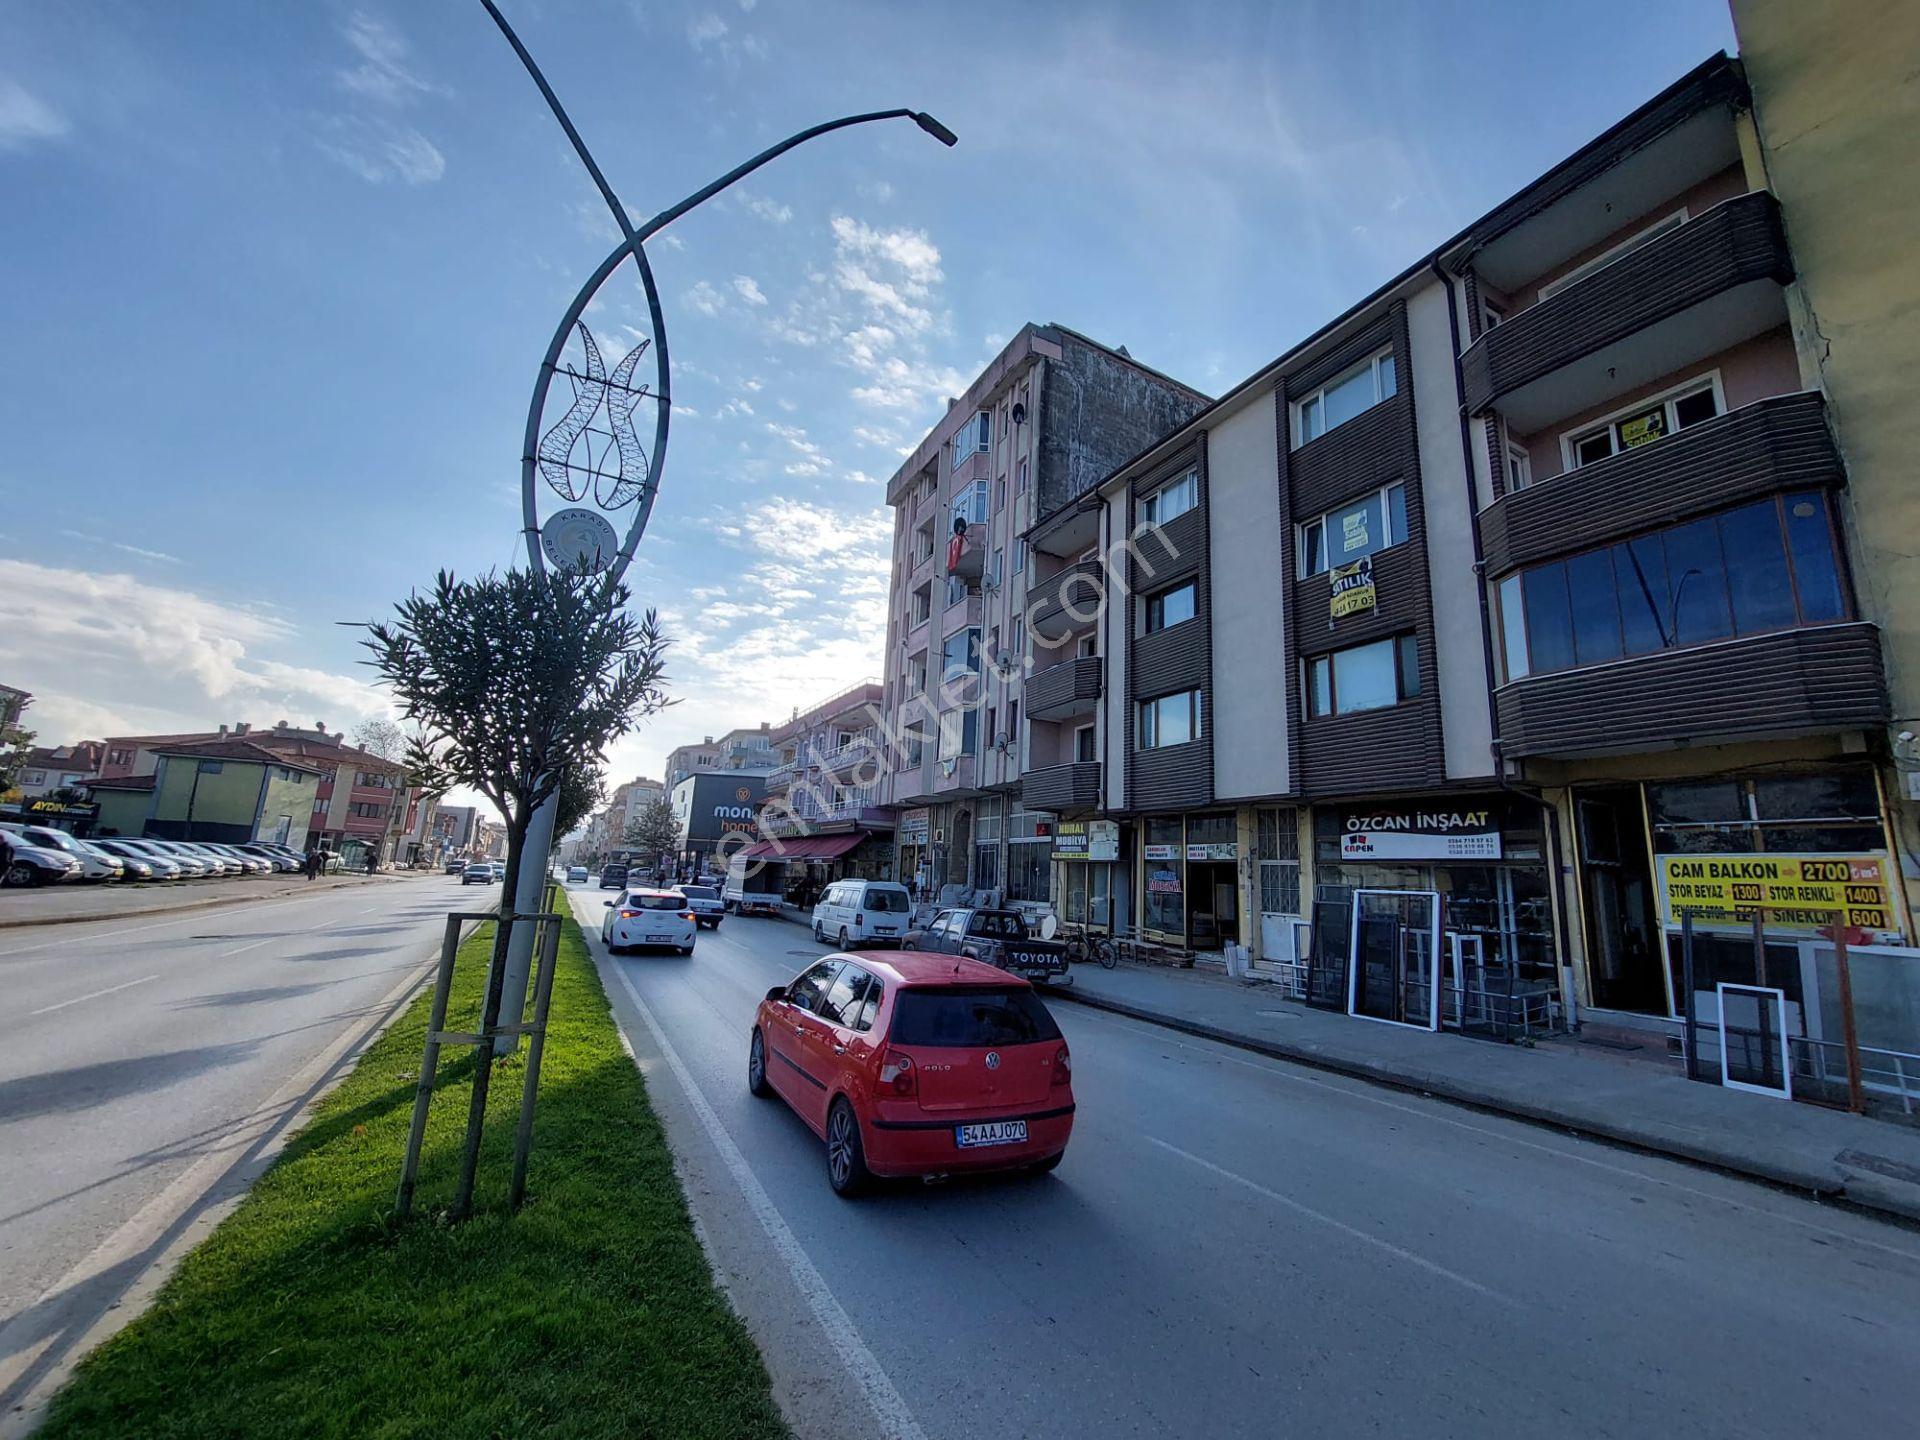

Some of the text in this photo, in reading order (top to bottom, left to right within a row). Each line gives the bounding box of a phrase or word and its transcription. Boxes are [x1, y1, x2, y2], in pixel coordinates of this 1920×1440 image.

[561, 512, 610, 534] KARASU
[31, 801, 67, 812] AYDIN
[721, 819, 758, 833] home
[1347, 811, 1489, 831] ÖZCAN İNŞAAT
[1670, 863, 1704, 878] CAM
[1709, 863, 1778, 879] BALKON
[1803, 862, 1849, 880] 2700
[1669, 884, 1693, 898] STOR
[1694, 884, 1724, 898] BEYAZ
[1734, 885, 1759, 899] 1300
[1769, 886, 1795, 900] STOR
[1846, 887, 1877, 902] 1400
[1852, 910, 1880, 926] 600
[1013, 952, 1060, 964] TOYOTA
